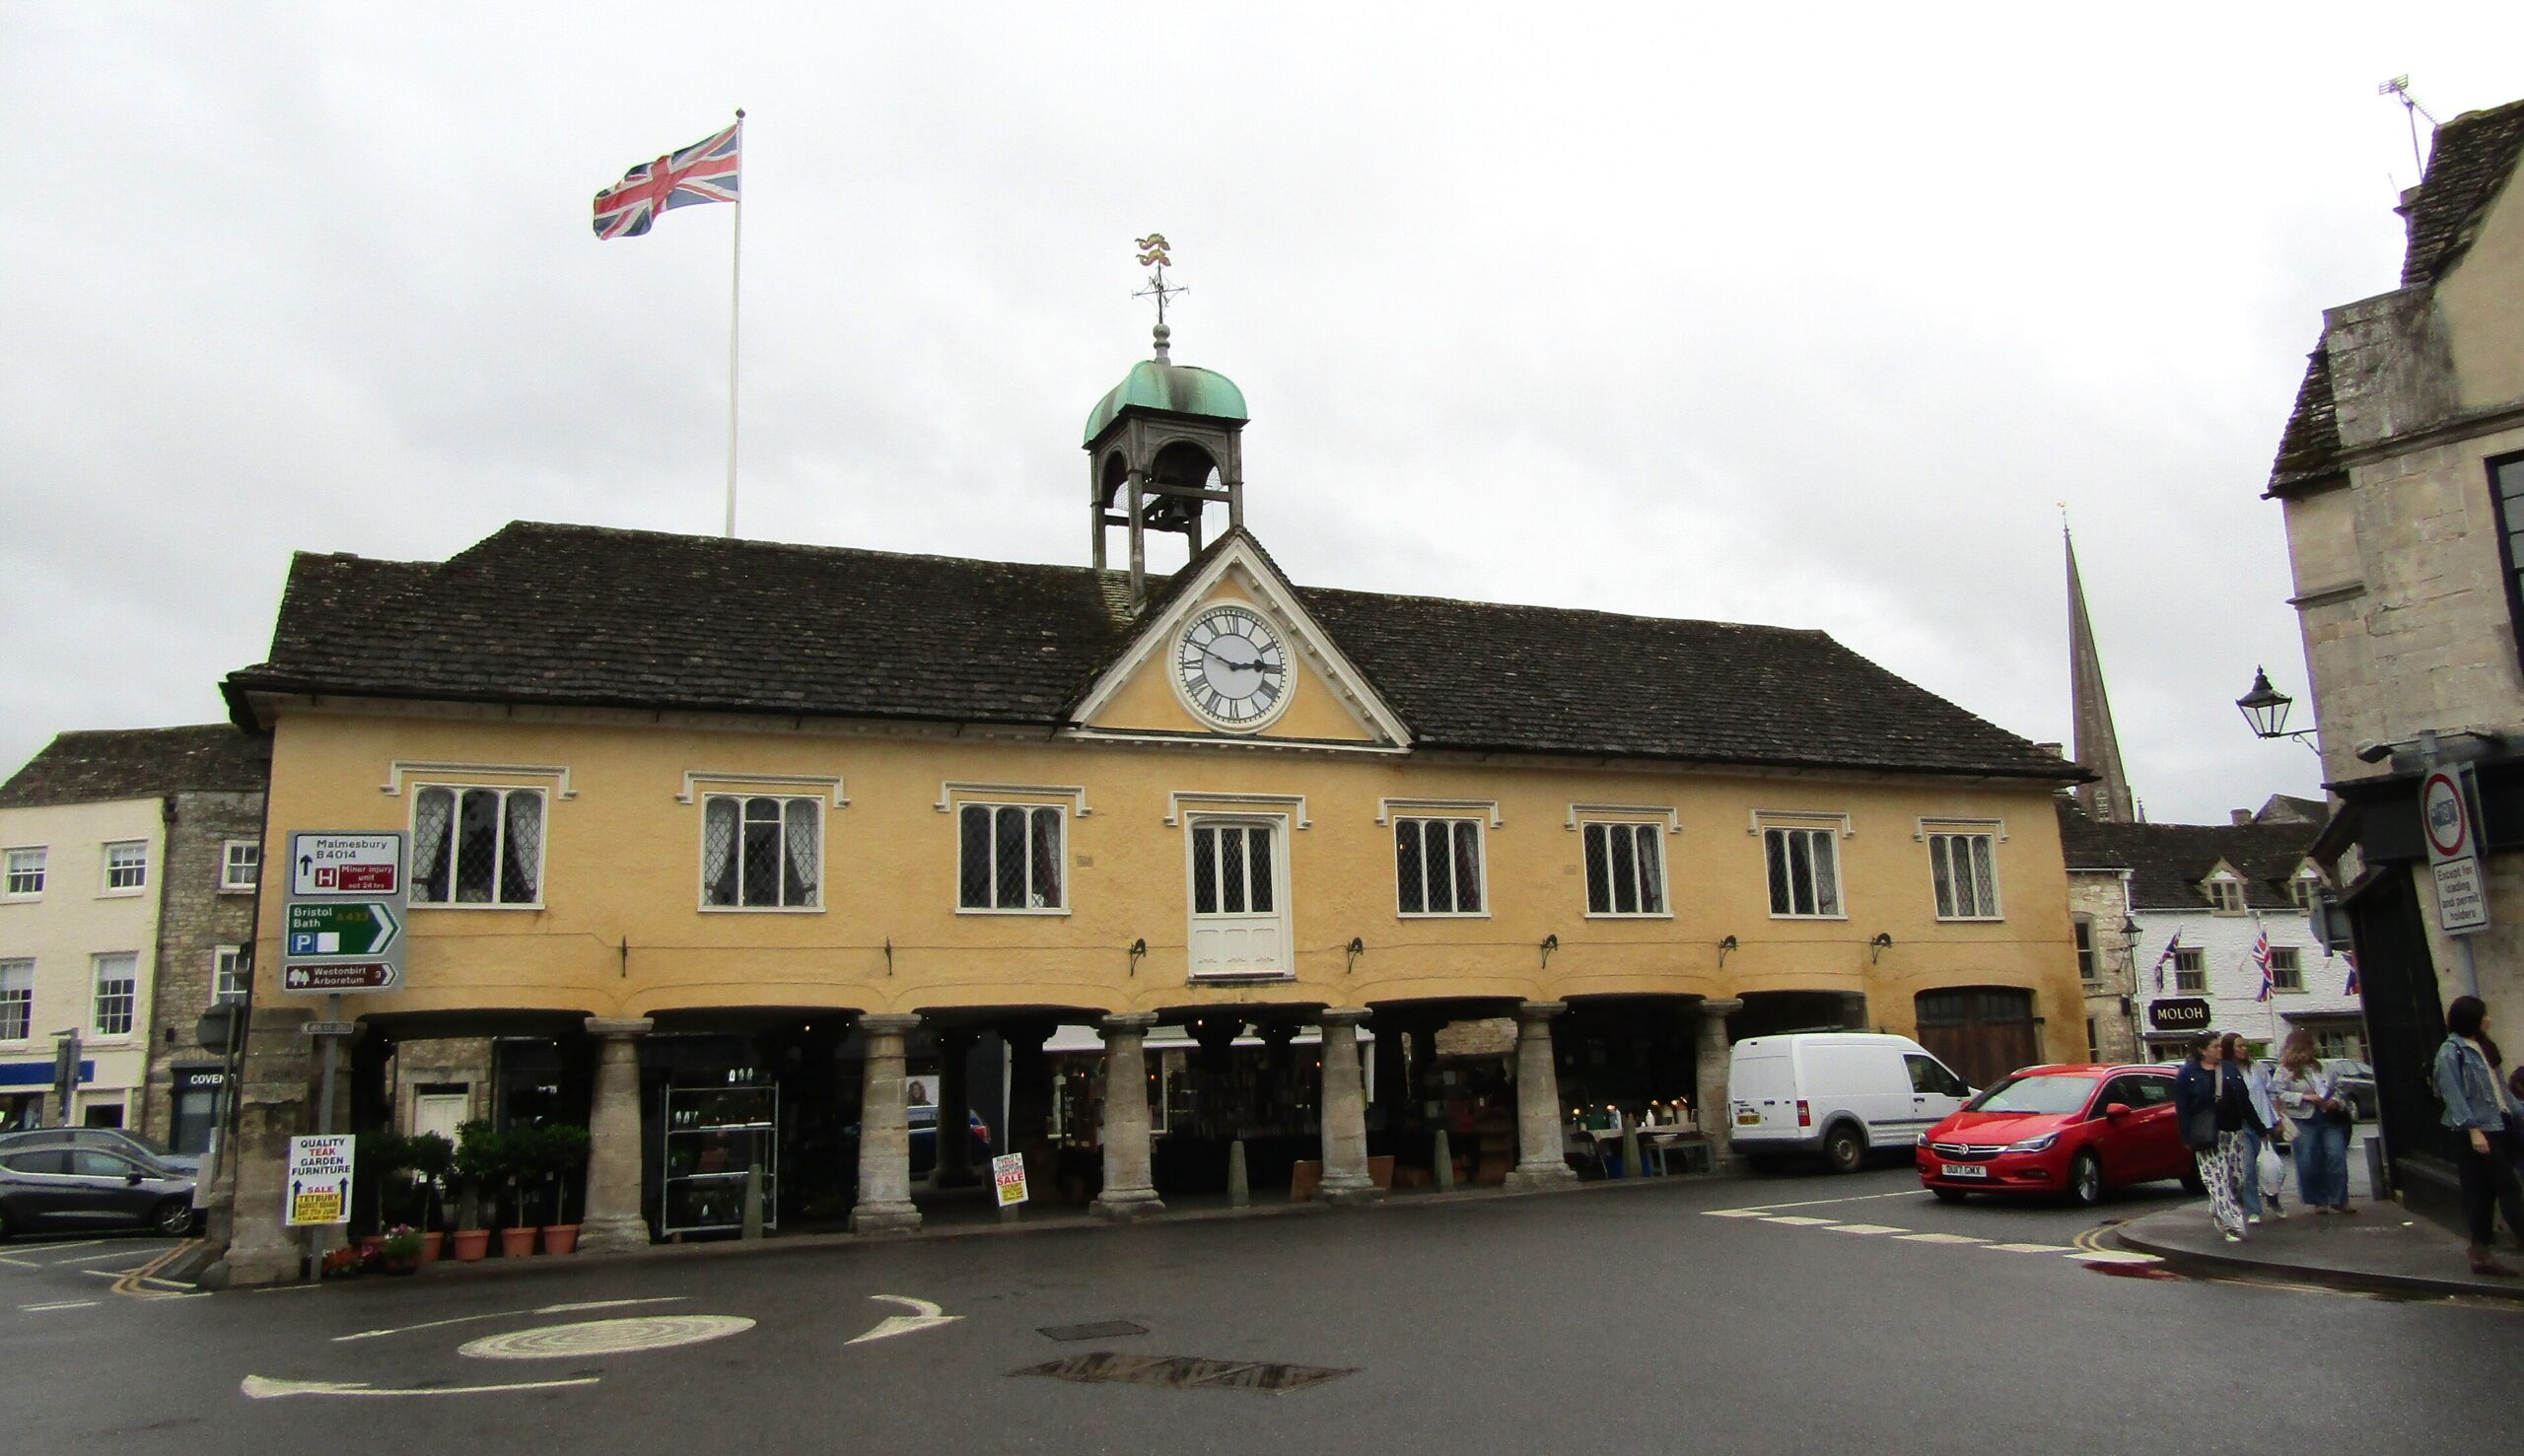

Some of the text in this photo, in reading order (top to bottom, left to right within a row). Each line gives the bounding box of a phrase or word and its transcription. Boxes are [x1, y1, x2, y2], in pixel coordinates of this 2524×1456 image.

[316, 839, 387, 850] Malmesbury
[316, 850, 357, 860] B4014
[369, 866, 392, 874] injury
[2436, 867, 2461, 881] Except
[318, 869, 333, 885] H
[2445, 880, 2471, 894] loading
[2441, 893, 2480, 909] and permit
[294, 907, 332, 917] Bristol
[2449, 910, 2477, 922] holders
[293, 918, 321, 928] Bath
[297, 935, 312, 950] P
[314, 967, 382, 979] Westonbirt 3
[314, 976, 365, 985] Arboretum
[2157, 1006, 2204, 1020] MOLOH
[300, 1138, 345, 1148] QUALITY
[310, 1147, 336, 1156] TEAK
[301, 1156, 344, 1166] GARDEN
[292, 1165, 351, 1176] FURNITURE
[997, 1173, 1024, 1186] SALE
